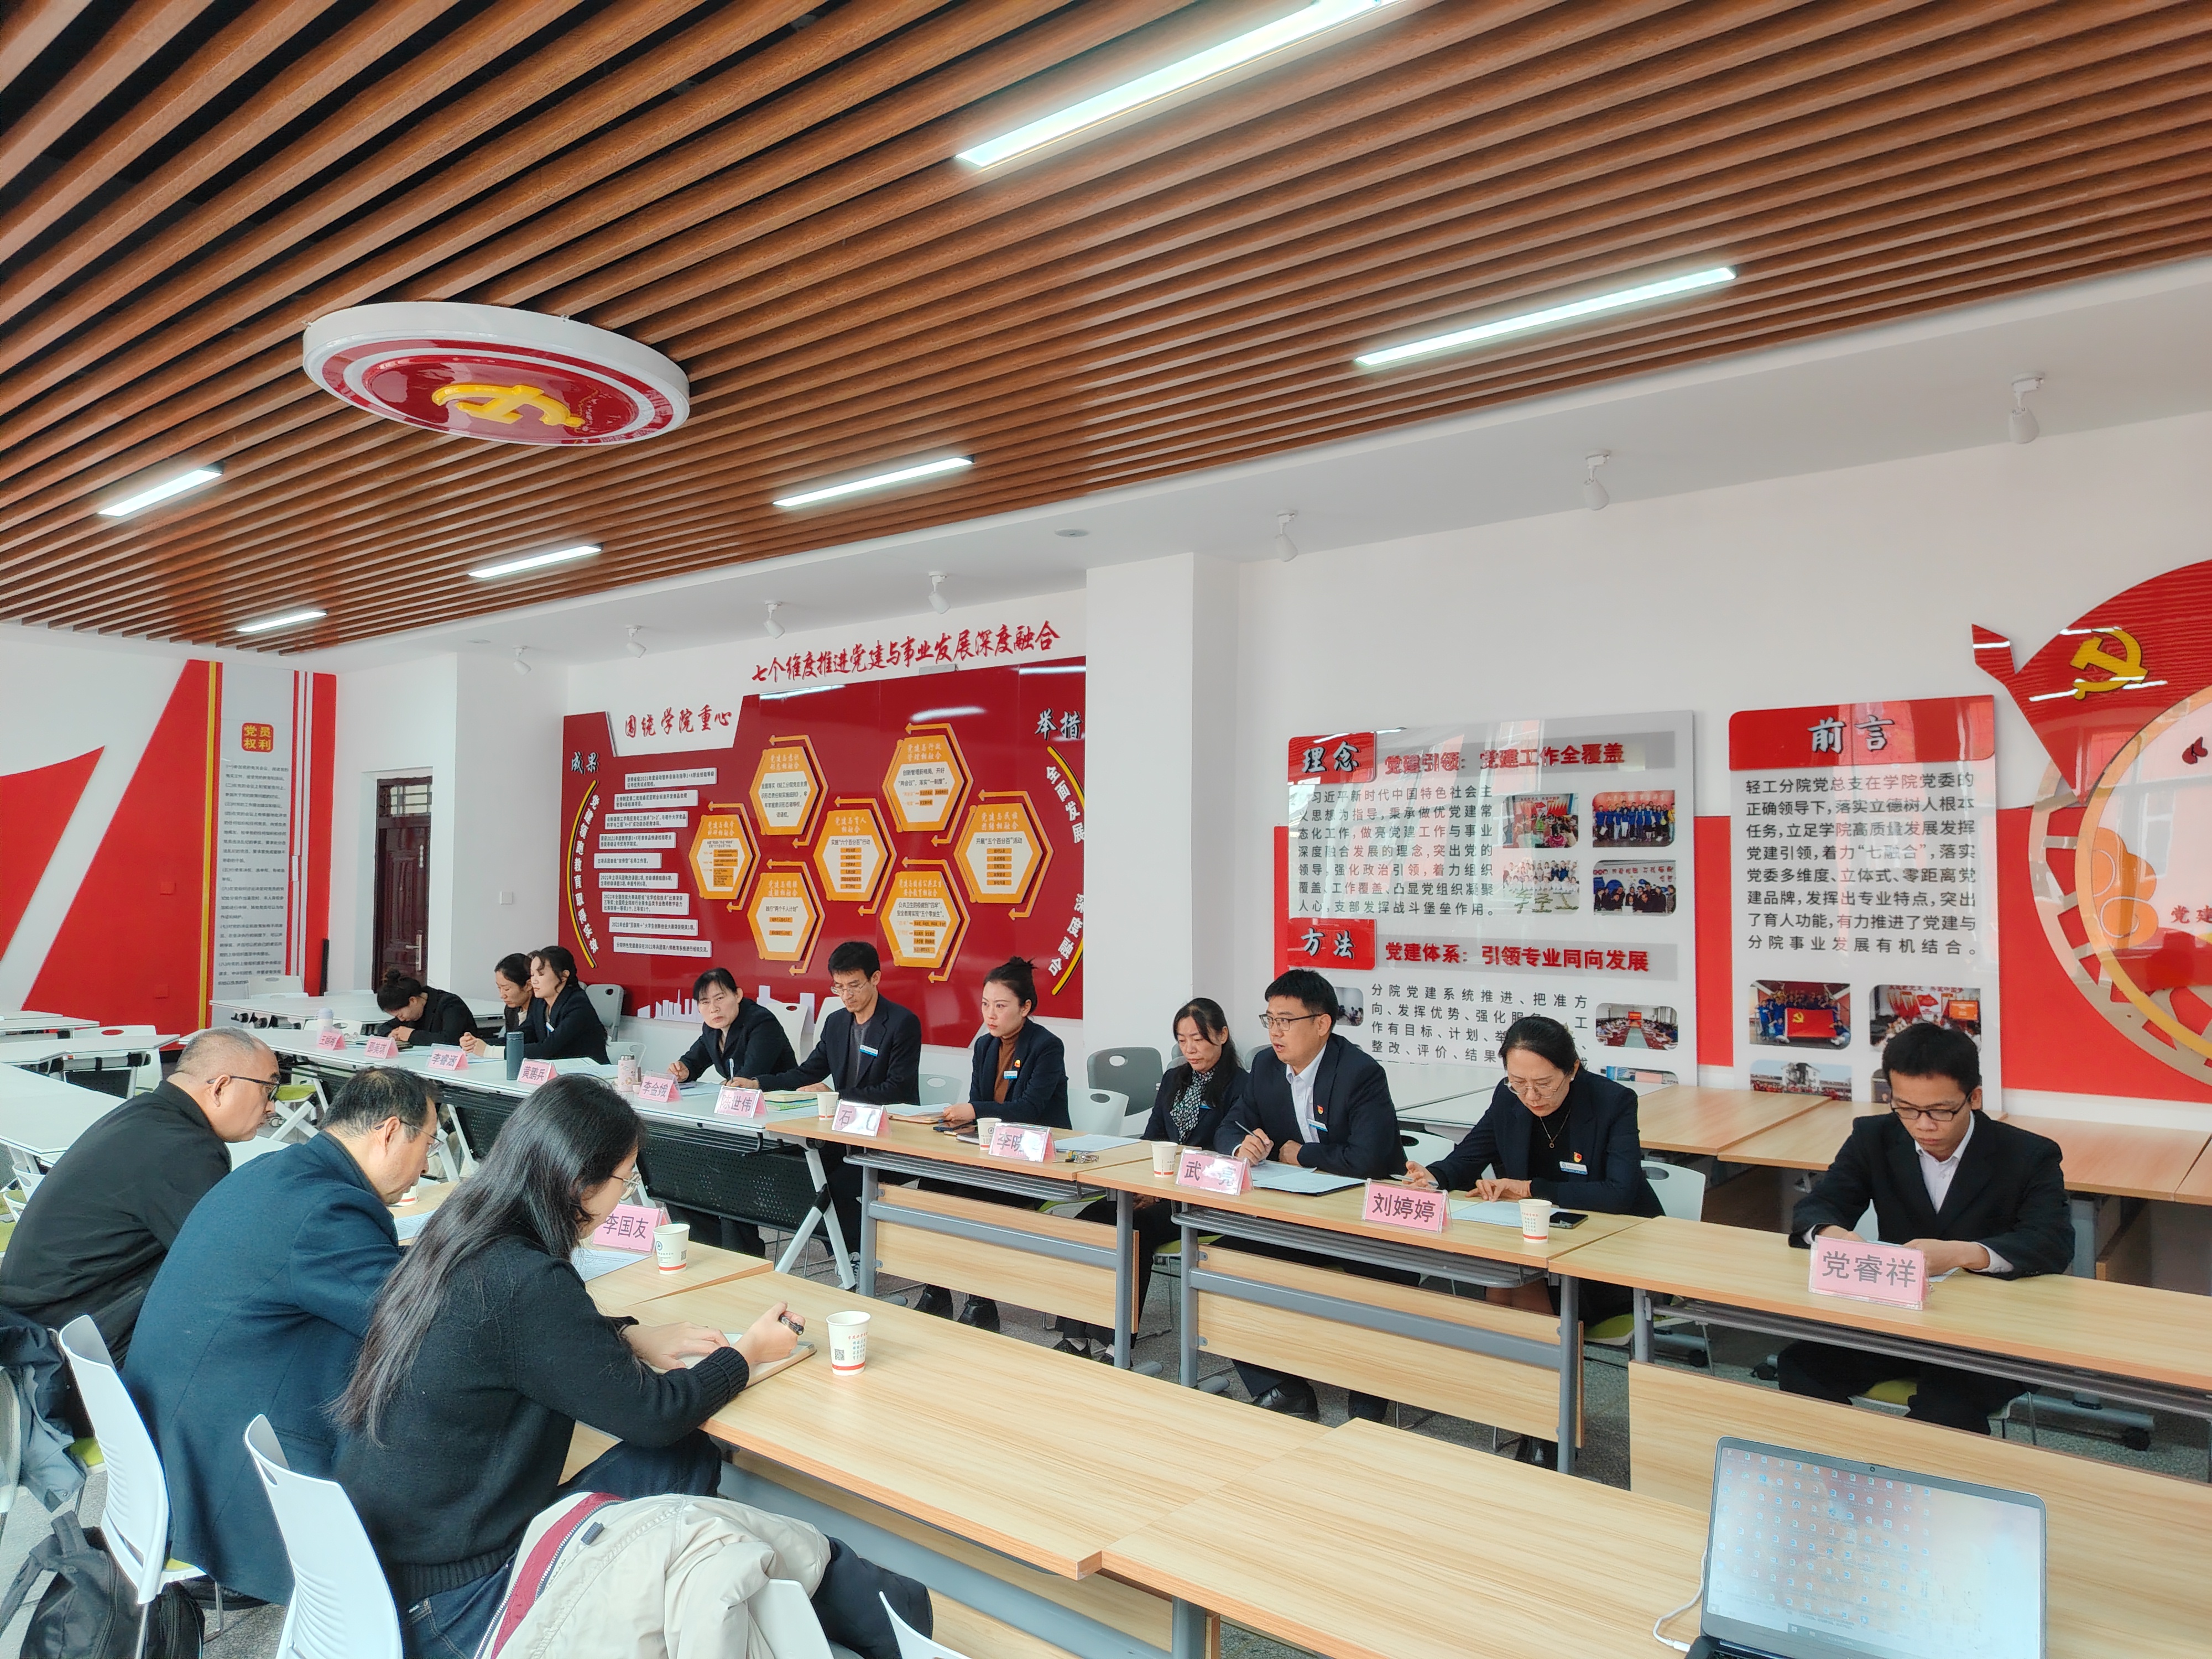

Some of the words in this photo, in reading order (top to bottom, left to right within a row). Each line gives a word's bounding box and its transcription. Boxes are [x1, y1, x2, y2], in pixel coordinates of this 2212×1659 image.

[752, 620, 1061, 683] 七个维度推进党建与事业发展深度融合
[244, 722, 272, 738] 党员
[625, 705, 733, 738] 围绕学院重心
[1035, 708, 1083, 740] 举措
[244, 738, 271, 750] 权利
[1807, 714, 1895, 754] 前言
[571, 751, 599, 775] 成果
[1302, 740, 1360, 773] 理念
[1746, 772, 1974, 794] 轻工分院党总支在学院党委的
[1046, 766, 1084, 844] 全面发展
[1312, 785, 1493, 804] 习近平新时代中国特色社会主
[1746, 796, 1975, 817] 正确领导下，落实立德树人根本
[1298, 823, 1493, 840] 态化工作，做亮党建工作与事业
[1746, 820, 1975, 839] 任务，立足学院高质量发展发挥
[1298, 844, 1493, 859] 深度融合发展的理念，突出党的
[1298, 863, 1493, 877] 领导，强化政治引领，着力组织
[1746, 867, 1976, 884] 党委多维度、立体式、零距离党
[1298, 881, 1494, 896] 覆盖、工作覆盖、凸显党组织凝聚
[1747, 890, 1976, 907] 建品牌，发挥出专业特点，突出
[1298, 900, 1493, 916] 人心，支部发挥战斗堡垒作用。
[2171, 905, 2212, 924] 党建
[1747, 912, 1976, 931] 了育人功能，有力推进了党建与
[1301, 927, 1357, 959] 方法
[1747, 935, 1976, 956] 分院事业发展有机结合。
[1385, 941, 1649, 972] 党建体系：引领专业同向发展
[1371, 983, 1588, 1009] 分院党建系统推进、把准方
[1373, 1192, 1436, 1223] 刘婷婷
[603, 1213, 650, 1239] 李国友
[1822, 1250, 1917, 1289] 党睿祥
